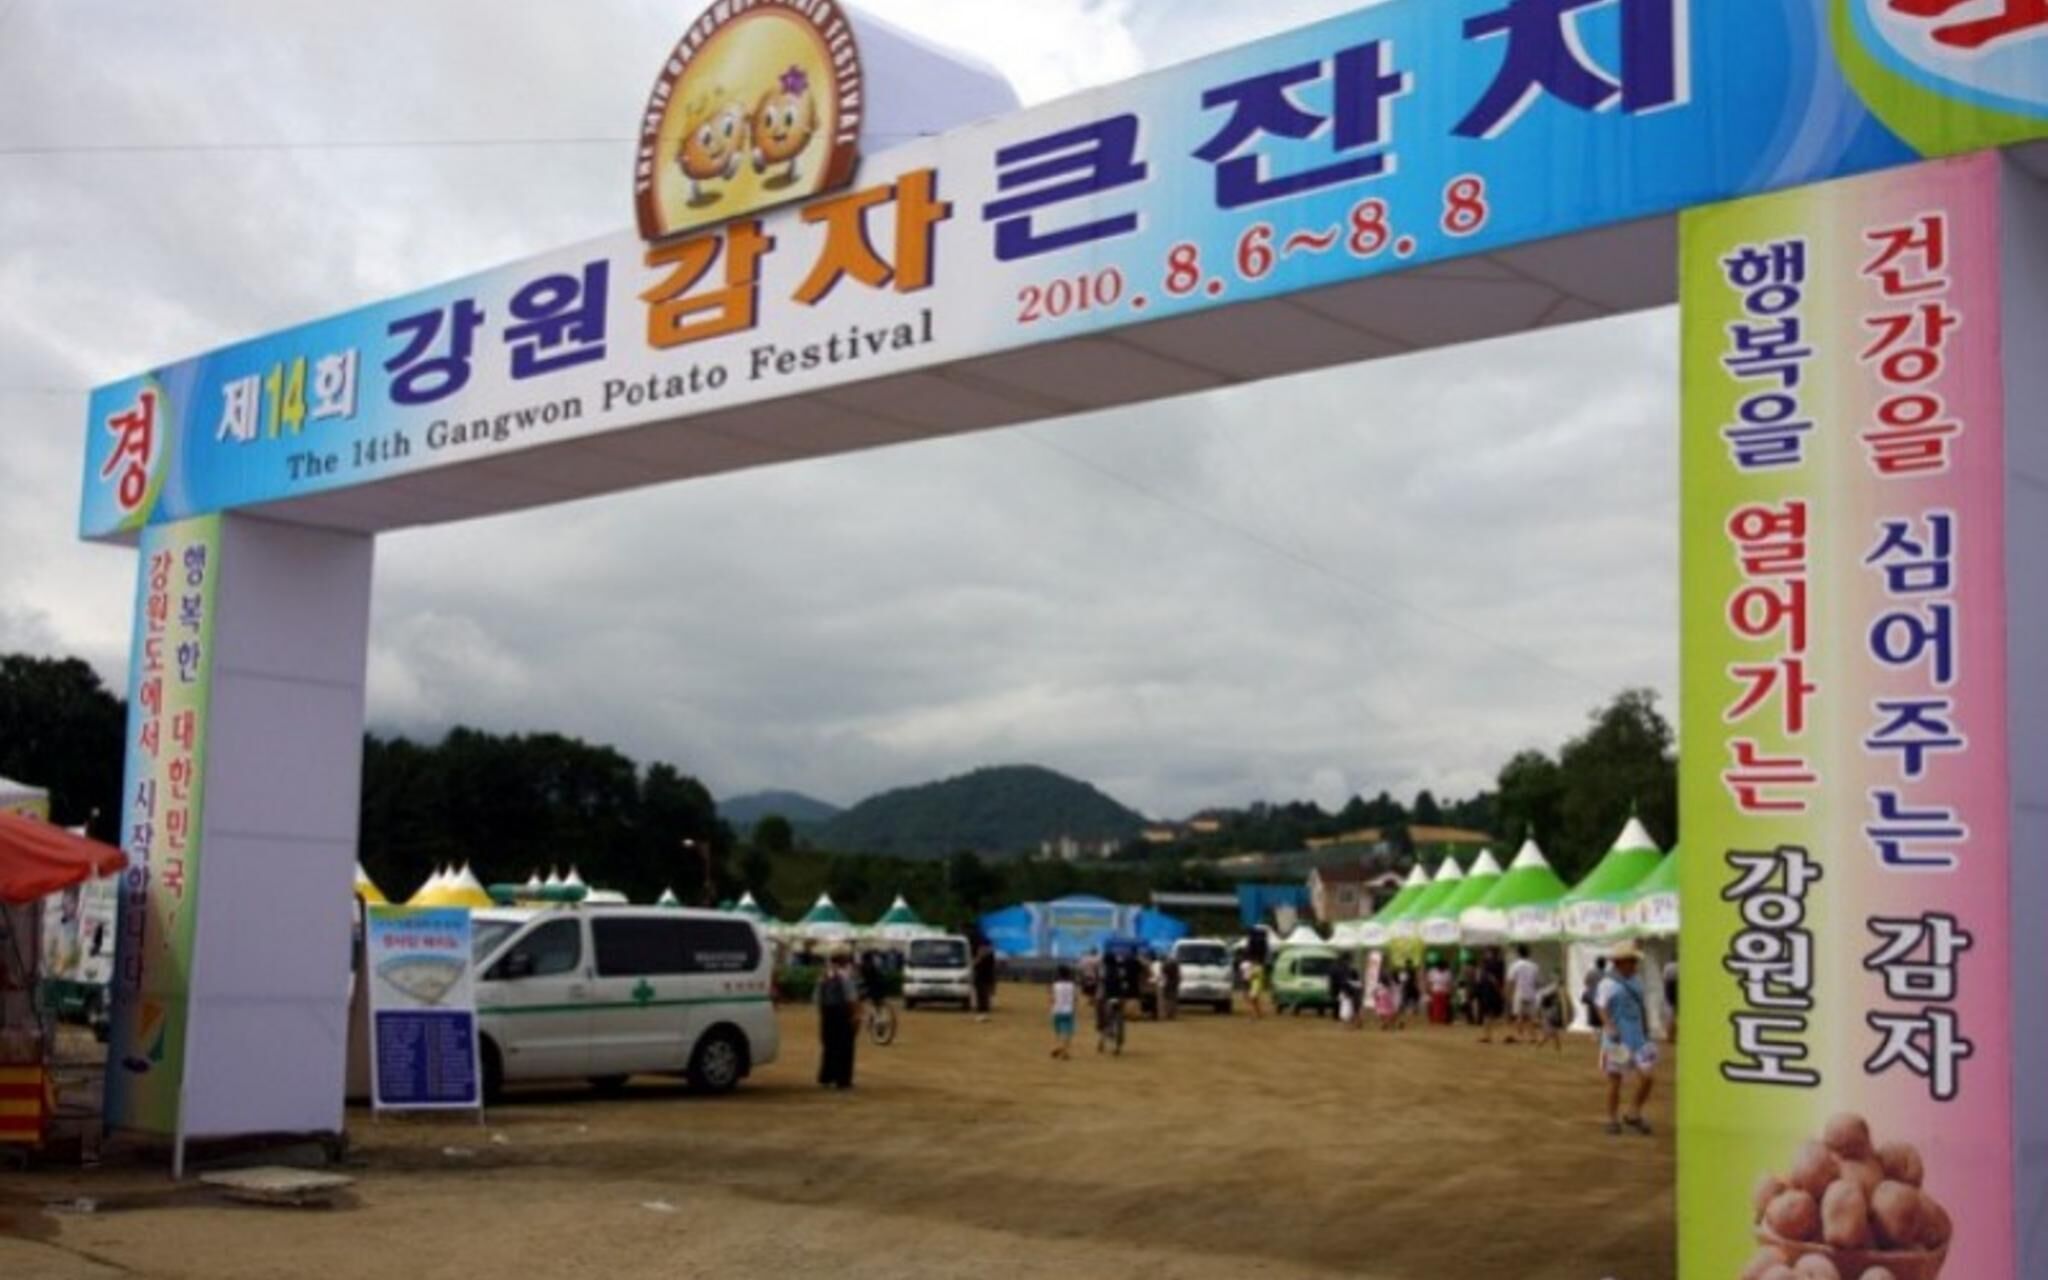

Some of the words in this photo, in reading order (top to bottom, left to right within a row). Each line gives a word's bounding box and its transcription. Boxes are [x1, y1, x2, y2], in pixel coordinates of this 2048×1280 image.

[100, 388, 157, 507] 경
[216, 349, 359, 442] 제14회
[287, 450, 338, 481] The
[352, 436, 411, 468] 14th
[426, 394, 583, 450] Gangwon
[602, 364, 728, 411] Potato
[747, 310, 935, 381] Festival
[1722, 239, 1813, 468] 행복을
[1861, 215, 1958, 474] 건강을
[176, 544, 207, 683] 행복한
[1723, 500, 1818, 811] 열어가는
[1865, 514, 1964, 866] 심어주는
[1720, 845, 1823, 1086] 강원도
[1864, 913, 1973, 1100] 감자
